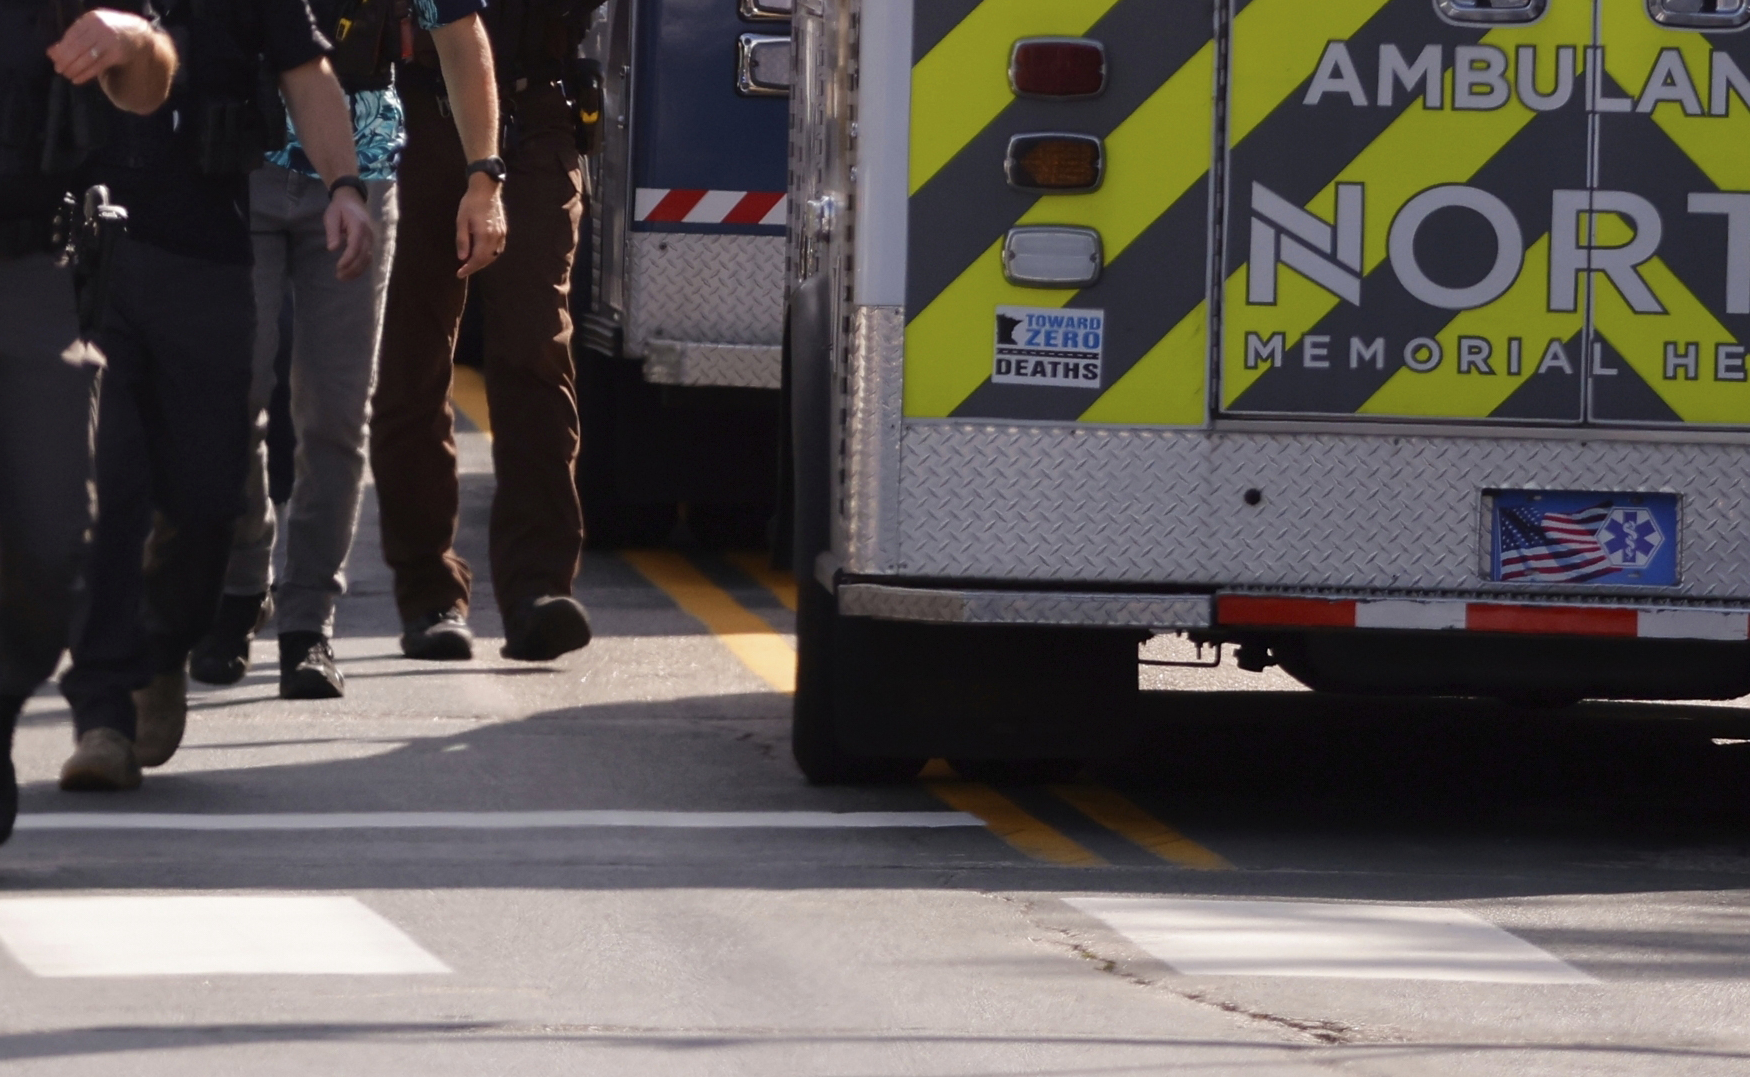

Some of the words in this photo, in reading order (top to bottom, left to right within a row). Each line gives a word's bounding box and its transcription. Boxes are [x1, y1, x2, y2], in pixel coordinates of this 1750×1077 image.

[1302, 39, 1750, 117] AMBULAN
[1025, 313, 1101, 331] TOWARD
[1024, 328, 1101, 351] ZERO
[1245, 331, 1619, 376] MEMORIAL
[994, 358, 1099, 381] DEATHS
